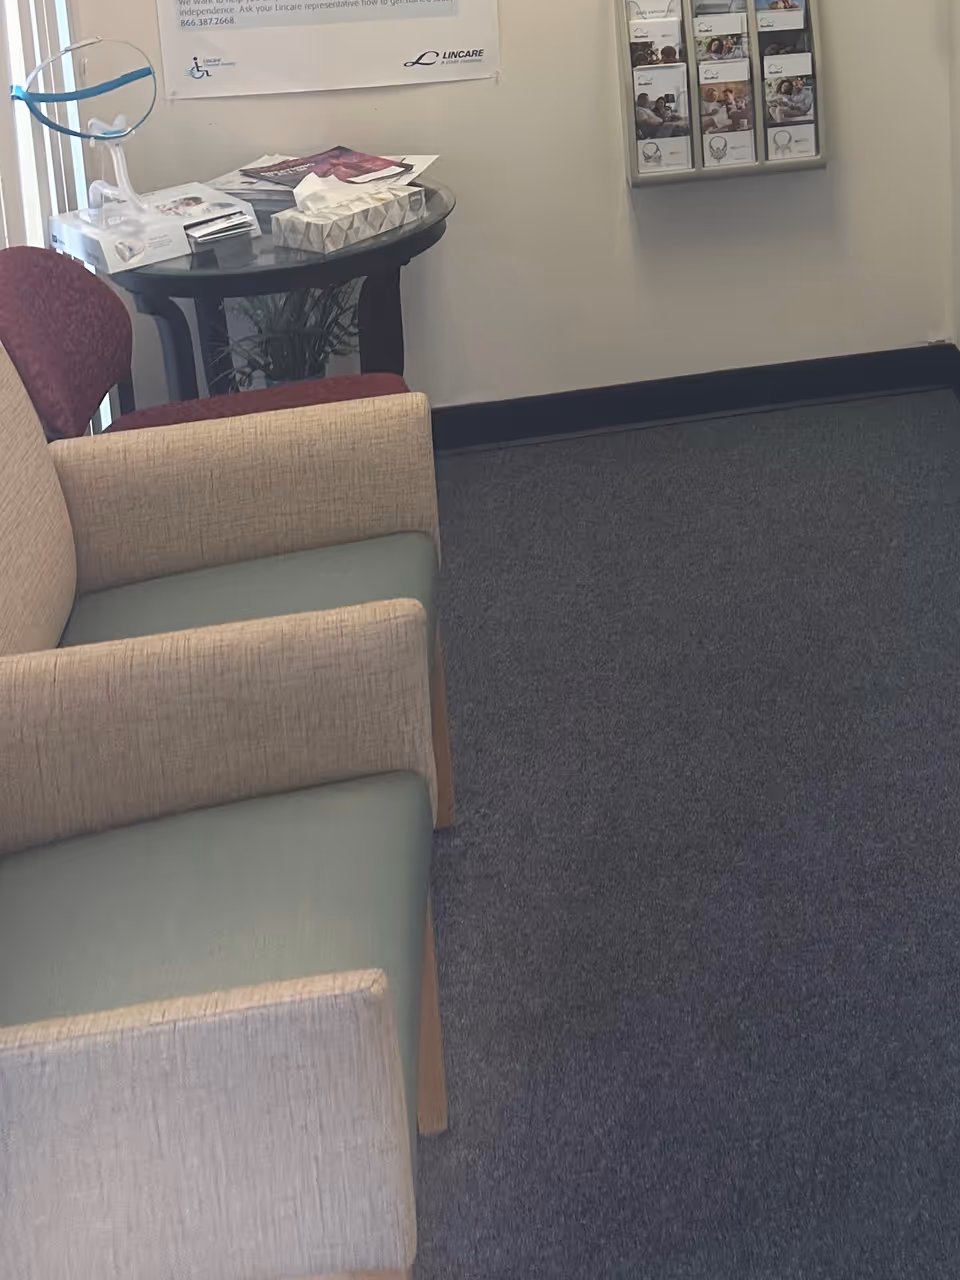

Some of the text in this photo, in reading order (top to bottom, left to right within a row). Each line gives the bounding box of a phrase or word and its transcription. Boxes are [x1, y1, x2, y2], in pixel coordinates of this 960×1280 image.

[240, 4, 253, 12] Ask
[255, 5, 272, 13] your
[275, 3, 301, 11] Lincare
[304, 0, 359, 11] representative
[361, 0, 378, 7] how
[442, 49, 485, 59] LINCARE
